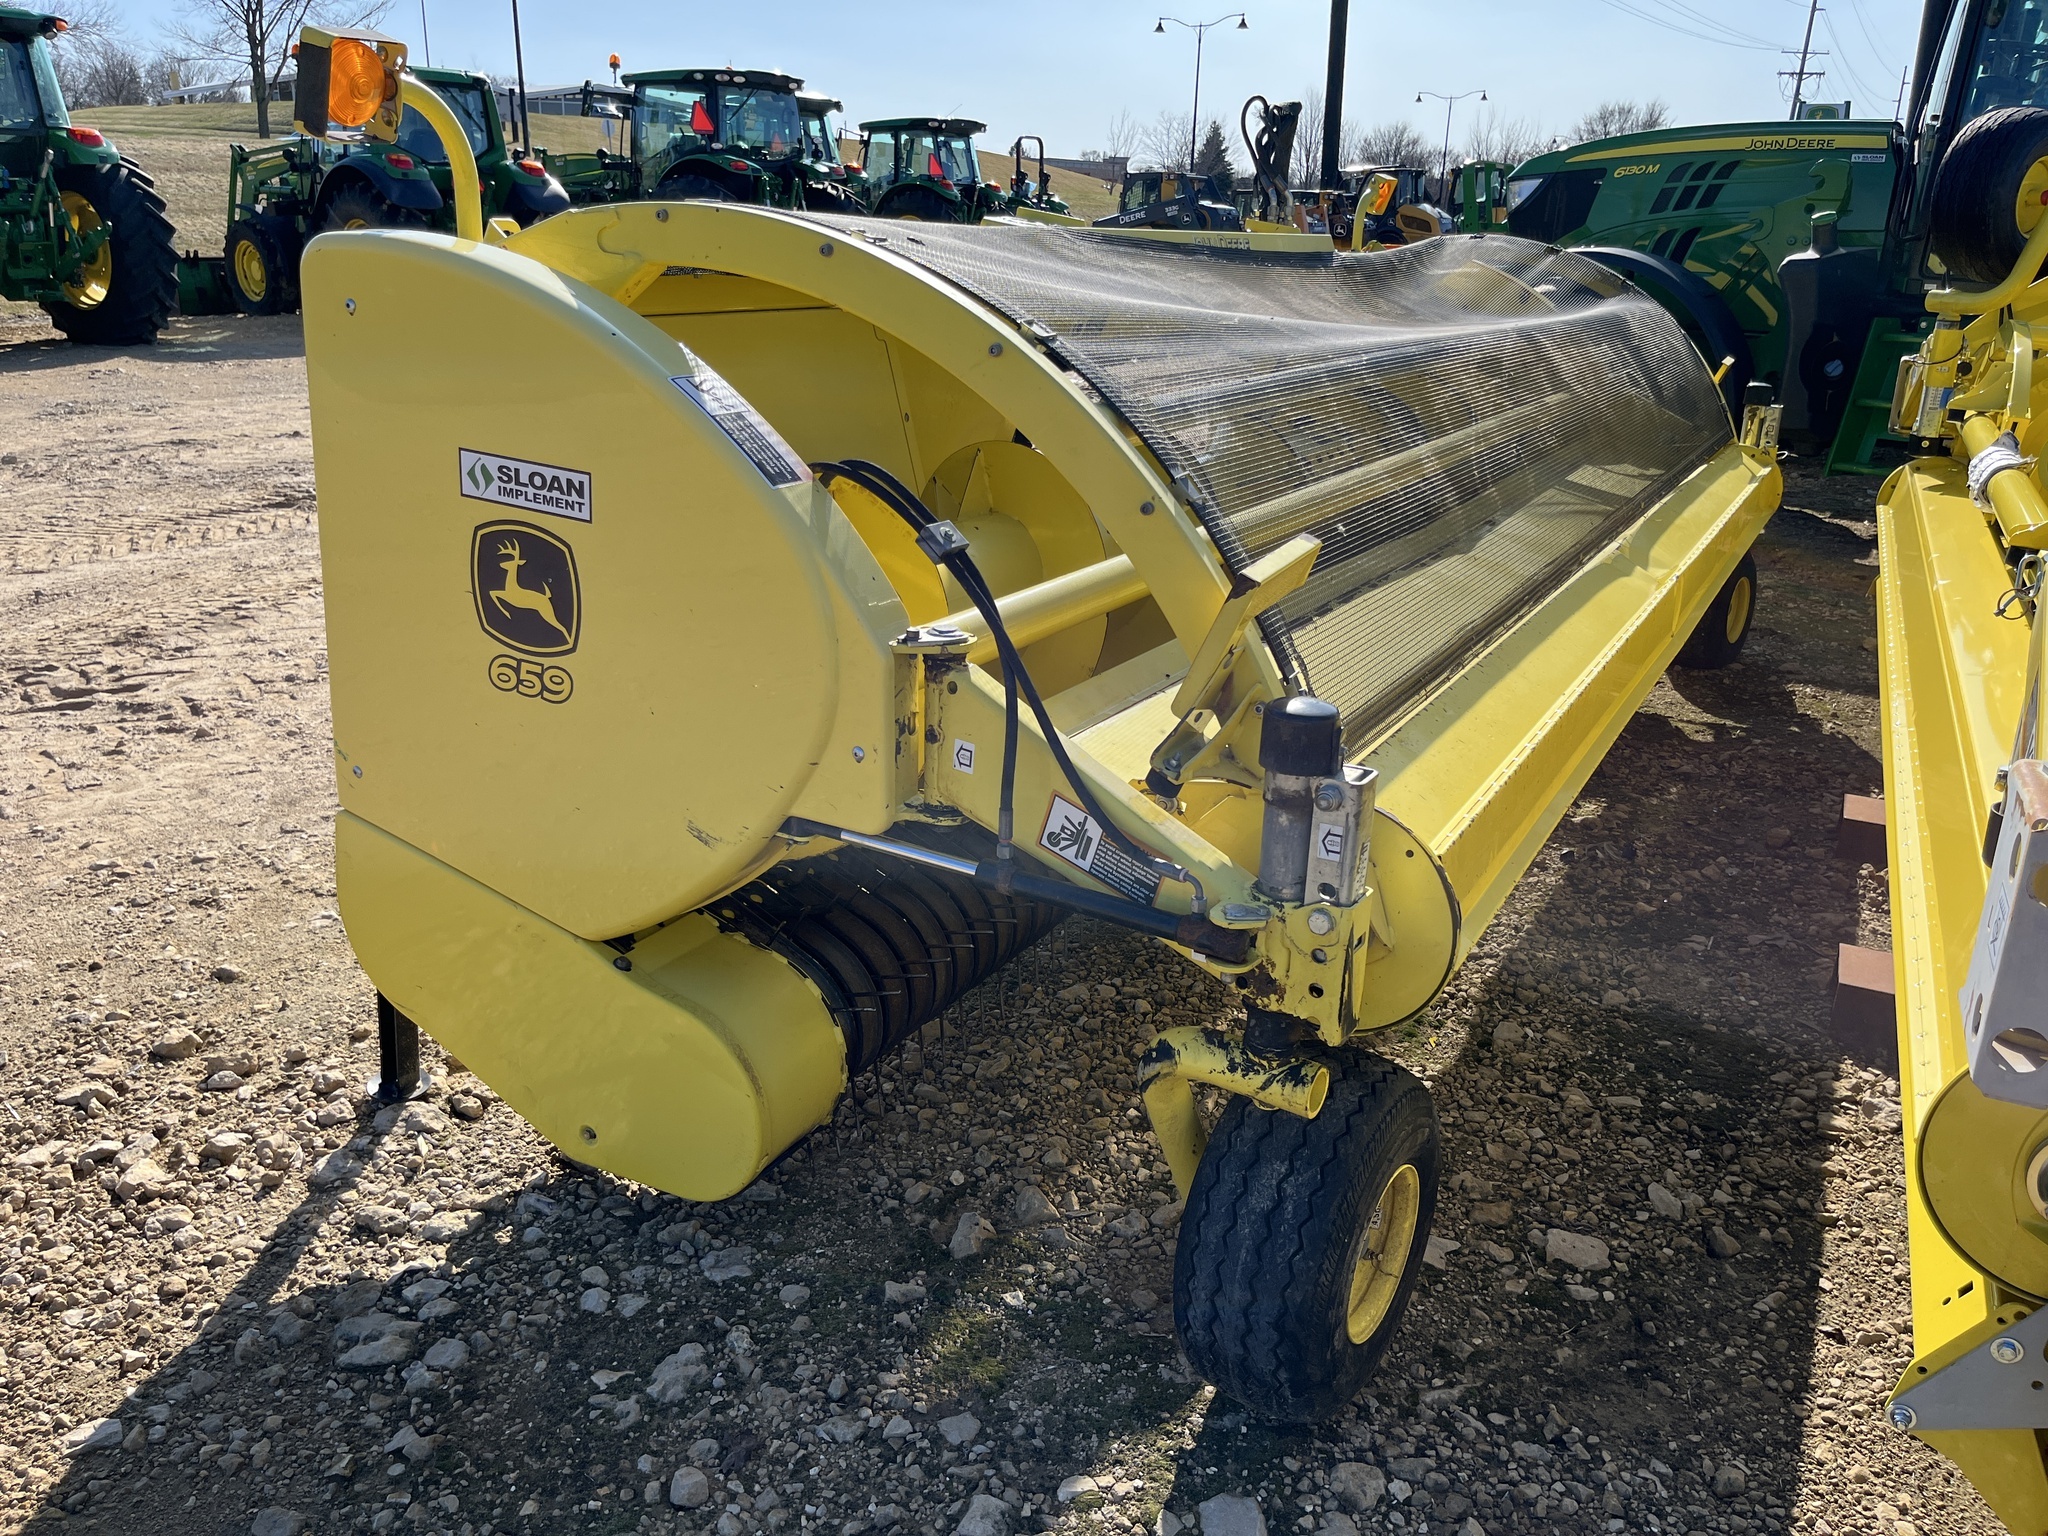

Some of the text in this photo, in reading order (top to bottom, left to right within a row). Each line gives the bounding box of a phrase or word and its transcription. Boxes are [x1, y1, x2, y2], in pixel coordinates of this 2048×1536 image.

[1744, 137, 1836, 150] JOHN DEERE
[1119, 210, 1146, 224] DEERE
[497, 465, 585, 500] SLOAN
[498, 486, 585, 513] IMPLEMENT
[488, 654, 574, 704] 659
[1105, 843, 1115, 851] avoid
